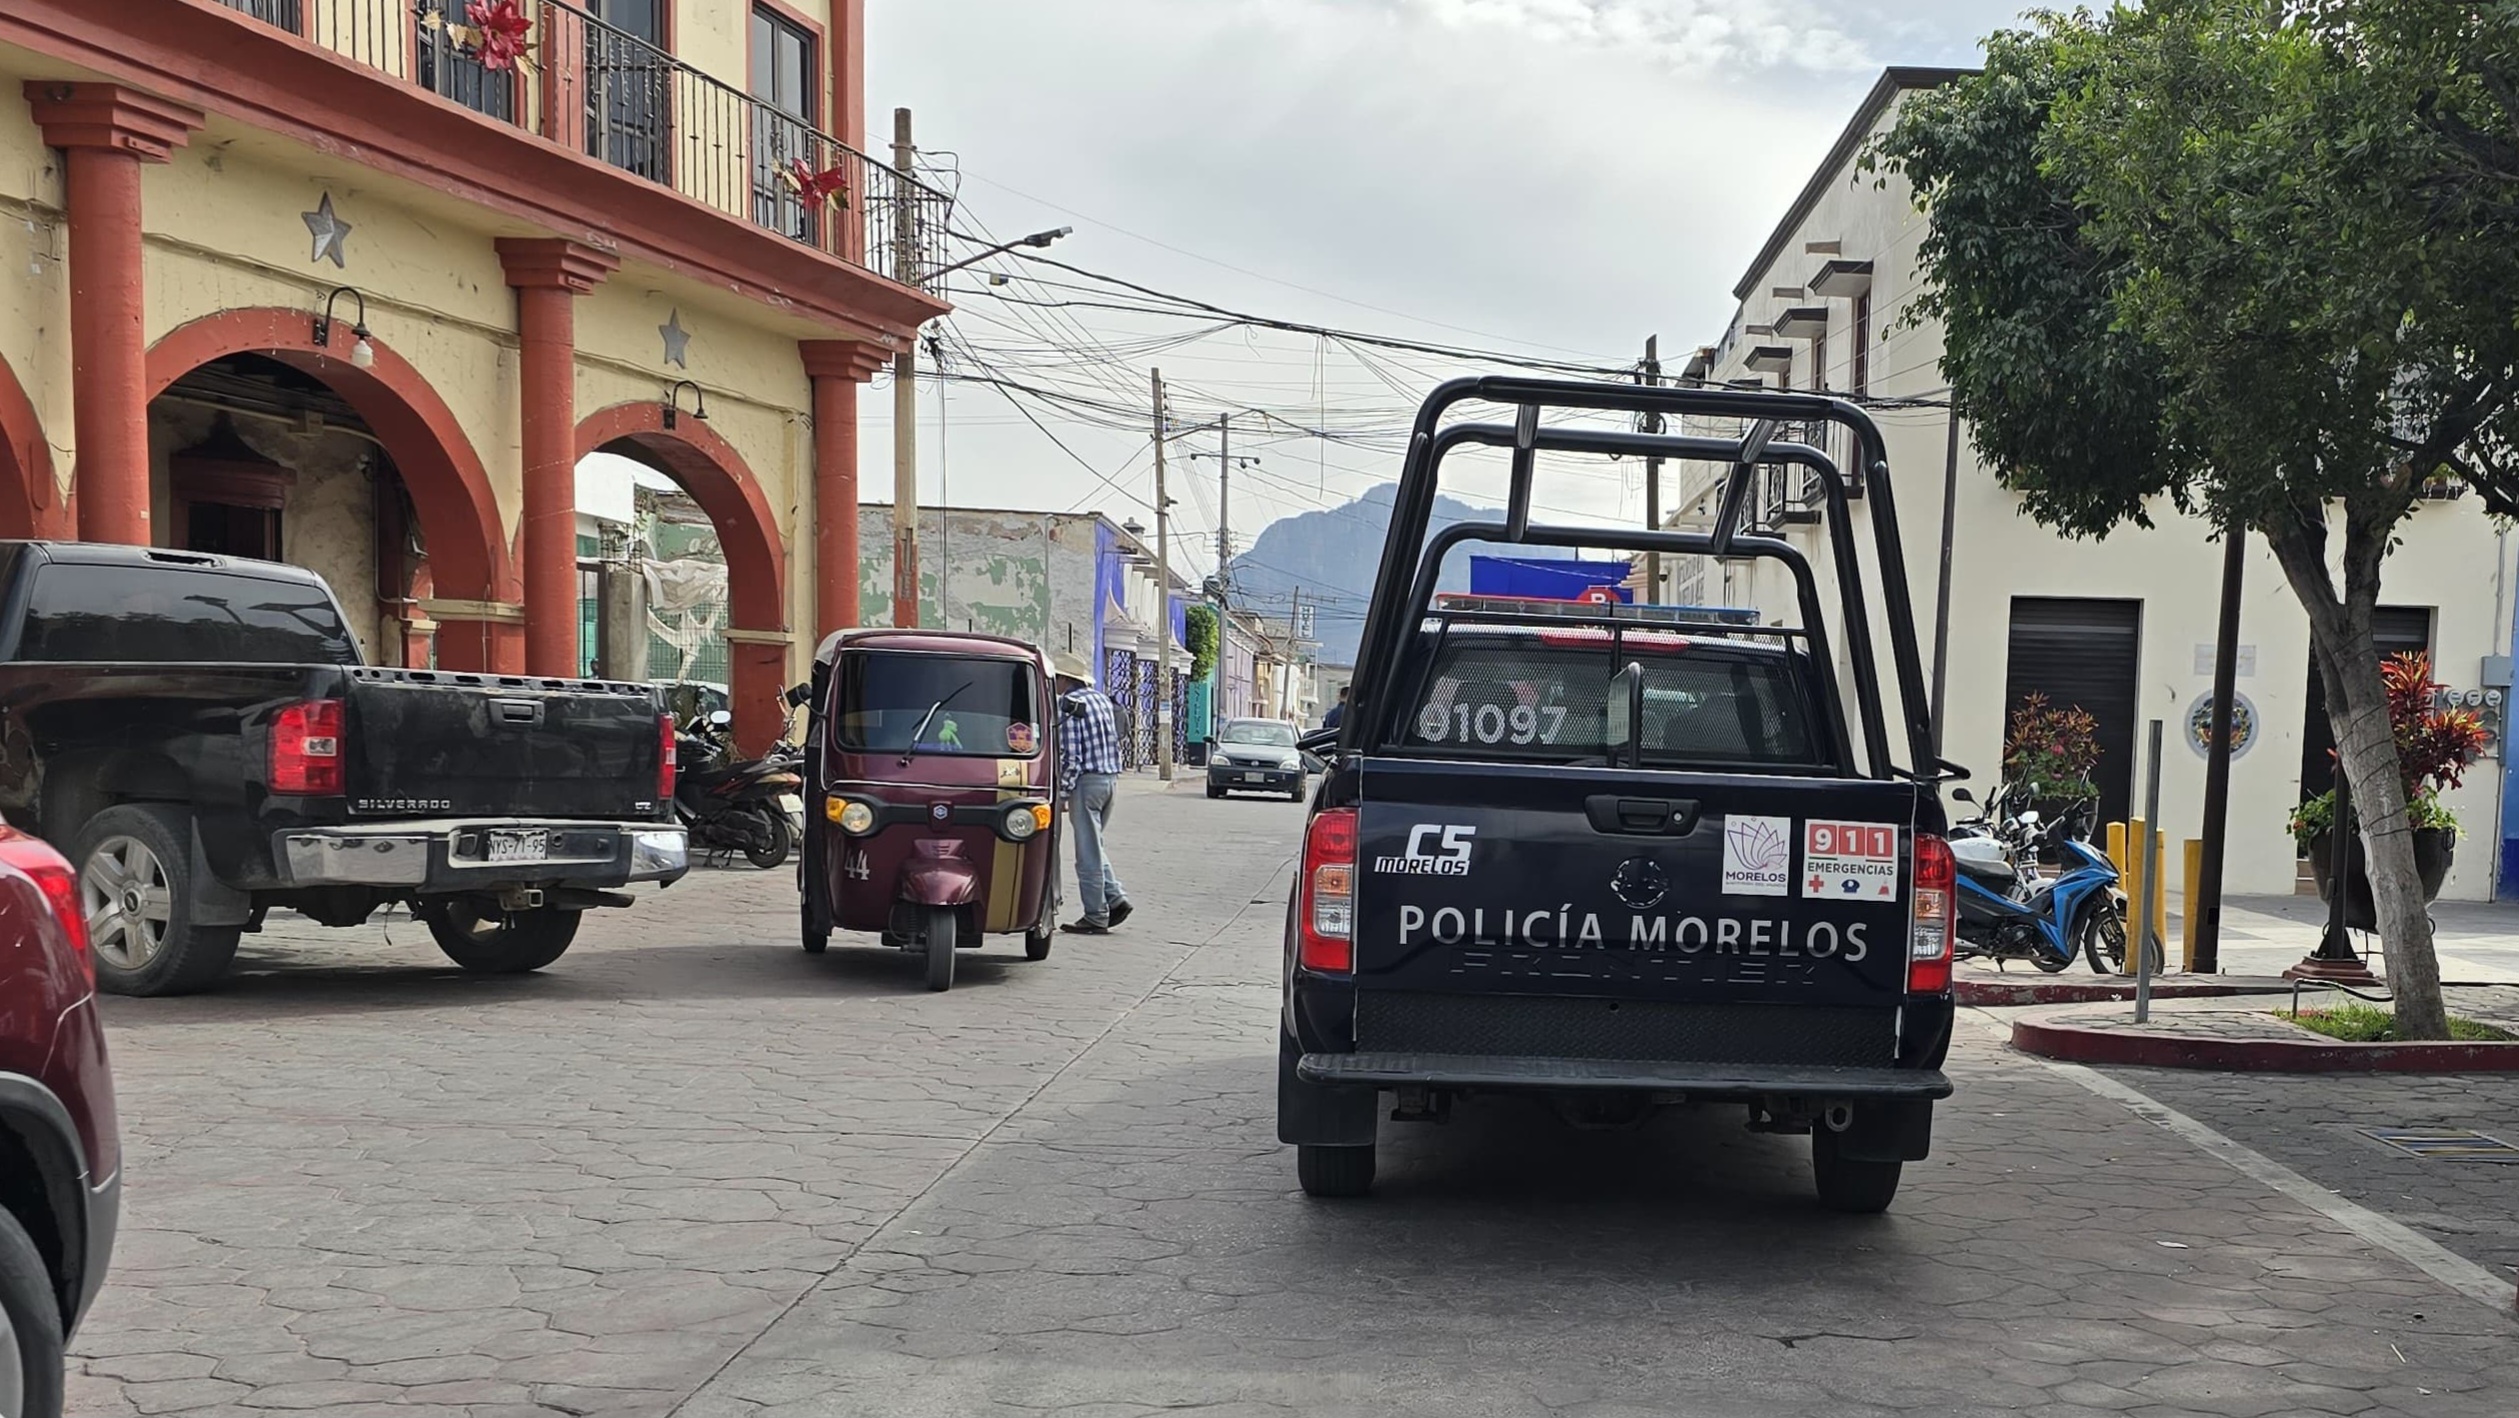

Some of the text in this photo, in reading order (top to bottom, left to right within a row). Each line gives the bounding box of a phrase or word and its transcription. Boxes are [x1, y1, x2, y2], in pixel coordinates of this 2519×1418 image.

[1301, 607, 1310, 637] HOTEL
[358, 799, 450, 809] SILVERADO
[1405, 824, 1476, 860] C5
[1814, 828, 1885, 854] 911
[844, 849, 870, 880] 44
[1375, 857, 1470, 875] MORELOS
[1725, 871, 1787, 883] MORELOS
[1807, 861, 1894, 876] EMERGENCIAS
[1399, 903, 1867, 962] POLICÍA MORELOS
